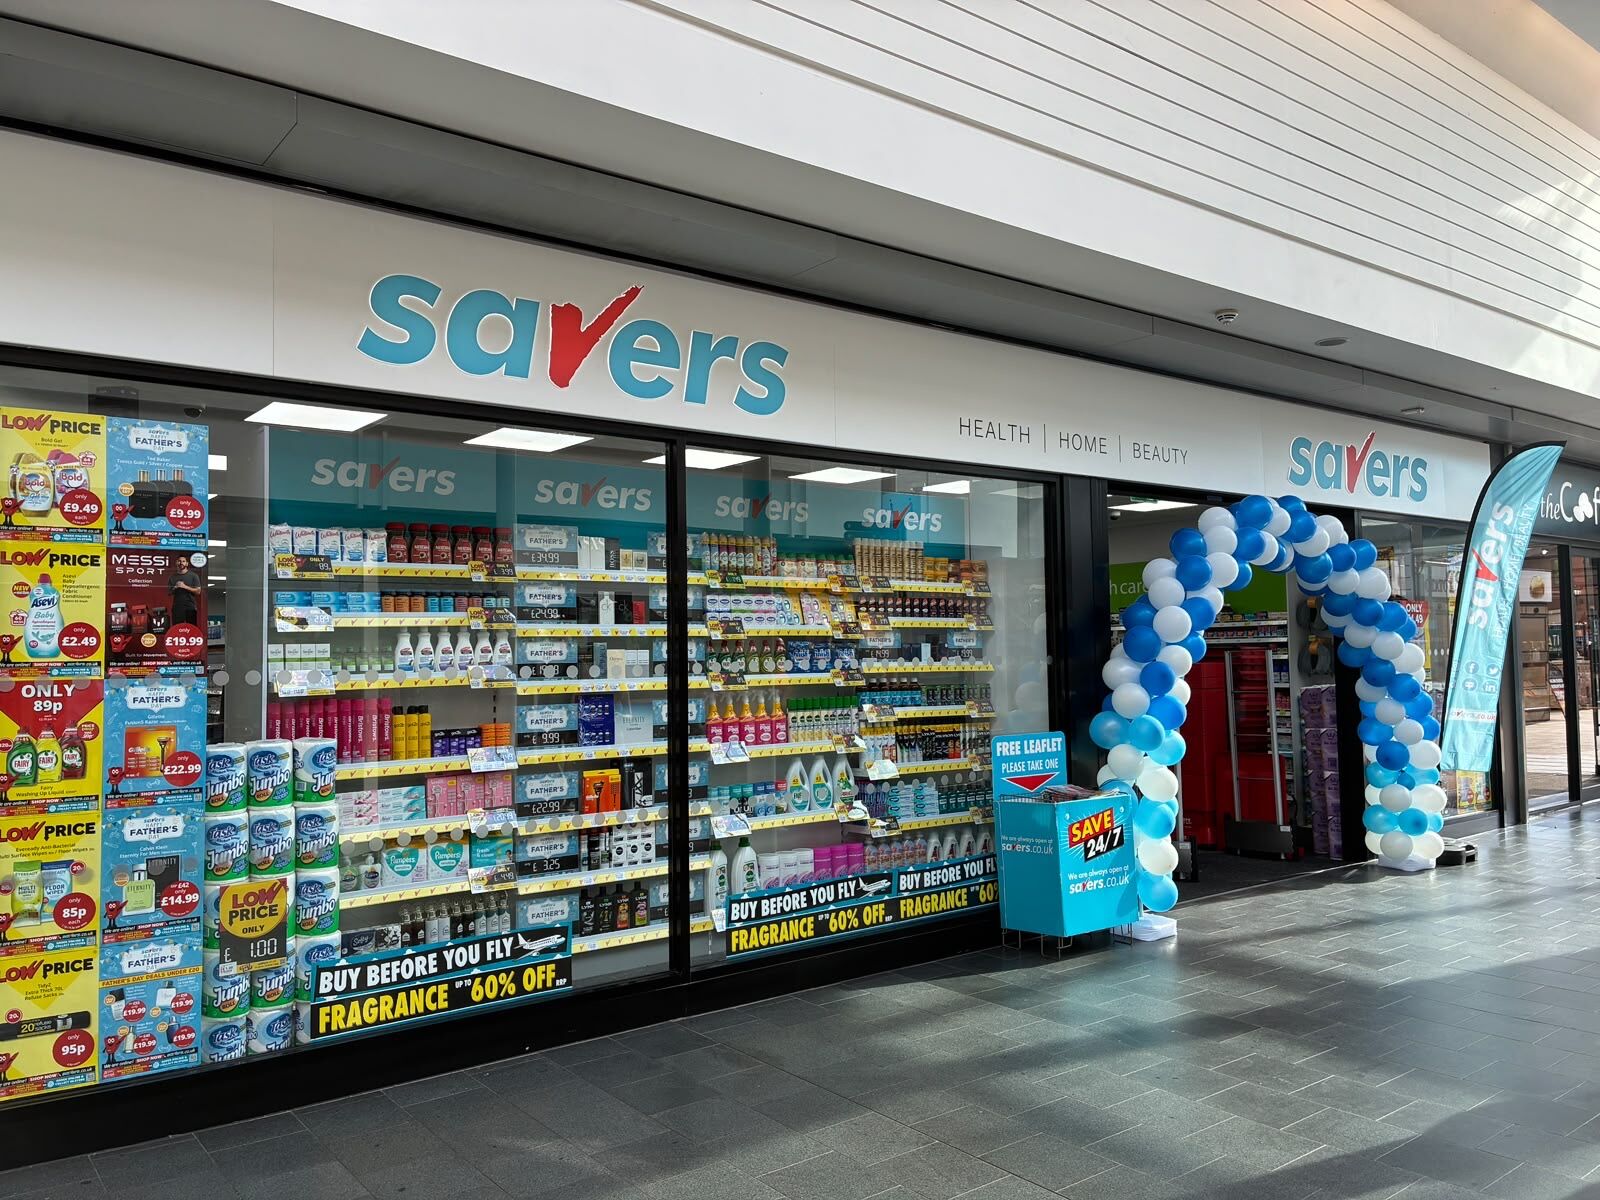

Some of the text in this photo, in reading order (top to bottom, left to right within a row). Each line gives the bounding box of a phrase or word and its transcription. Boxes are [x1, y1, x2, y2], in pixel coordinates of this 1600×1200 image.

[356, 273, 790, 416] savers
[1, 414, 101, 435] LOW PRICE
[135, 437, 182, 447] FATHER'S
[959, 417, 1188, 465] HEALTH HOME BEAUTY
[1288, 430, 1428, 502] savers
[61, 472, 83, 481] Bold
[311, 456, 456, 496] savers
[534, 476, 652, 512] savers
[63, 502, 98, 513] £9.49
[169, 508, 201, 518] £9.99
[715, 491, 809, 523] savers
[861, 499, 943, 533] savers
[529, 537, 563, 545] FATHER'S
[0, 548, 101, 568] LOW PRICE
[531, 552, 560, 563] £34.99
[115, 567, 165, 575] SPORT
[1468, 502, 1514, 629] savers
[31, 595, 56, 608] Asevi
[34, 611, 55, 619] Baby
[531, 608, 559, 619] £24.99
[61, 636, 97, 646] £2.49
[165, 636, 203, 646] £19.99
[21, 684, 76, 698] ONLY
[132, 695, 180, 704] FATHER'S
[33, 700, 63, 714] 89p
[541, 732, 560, 743] 9.99
[996, 737, 1063, 756] FREE LEAFLET
[39, 756, 54, 764] FAIRY
[64, 753, 78, 761] FAIRY
[14, 760, 30, 768] FAIRY
[163, 764, 201, 775] £22.99
[1001, 758, 1059, 773] PLEASE TAKE ONE
[206, 773, 245, 799] Jumbo
[250, 769, 290, 795] Jumbo
[530, 786, 564, 795] FATHER'S
[532, 801, 560, 814] £22.99
[44, 822, 96, 841] PRICE
[129, 825, 178, 836] FATHER'S
[1071, 810, 1112, 842] SAVE
[297, 832, 336, 857] Jumbo
[1017, 835, 1032, 844] always
[1086, 826, 1123, 859] 24/7
[208, 840, 248, 870] Jumbo
[251, 837, 292, 864] Jumbo
[531, 844, 565, 853] FATHER'S
[1001, 842, 1053, 855] savers.co.uk
[390, 856, 416, 865] Pampers
[434, 851, 461, 861] Pampers
[543, 859, 560, 870] 3.25
[900, 873, 921, 891] BUY
[923, 864, 961, 889] BEFORE
[963, 860, 984, 878] YOU
[1068, 864, 1129, 881] We are always open at
[1069, 873, 1130, 895] savers.co.uk
[160, 893, 199, 906] £14.99
[232, 882, 282, 909] LOW
[730, 880, 856, 921] BUY BEFORE YOU FLY
[900, 886, 968, 919] FRAGRANCE
[62, 908, 87, 919] 85p
[228, 904, 279, 927] PRICE
[296, 899, 336, 924] Jumbo
[531, 909, 565, 919] FATHER'S
[242, 924, 265, 934] ONLY
[731, 916, 815, 953] FRAGRANCE
[829, 908, 859, 933] 60%
[862, 903, 886, 924] OFF
[224, 938, 277, 962] £ 1.00
[127, 954, 176, 968] FATHER'S
[318, 936, 514, 994] BUY BEFORE YOU FLY
[42, 958, 94, 979] PRICE
[102, 977, 131, 987] FATHER'S
[171, 999, 194, 1008] £19.99
[318, 963, 567, 1034] FRAGRANCE UP TO 60% OFF RRP
[123, 1007, 146, 1017] £19.99
[21, 1023, 35, 1033] 20
[173, 1032, 196, 1042] £19.99
[61, 1044, 86, 1056] 95p
[133, 1040, 157, 1049] £19.99
